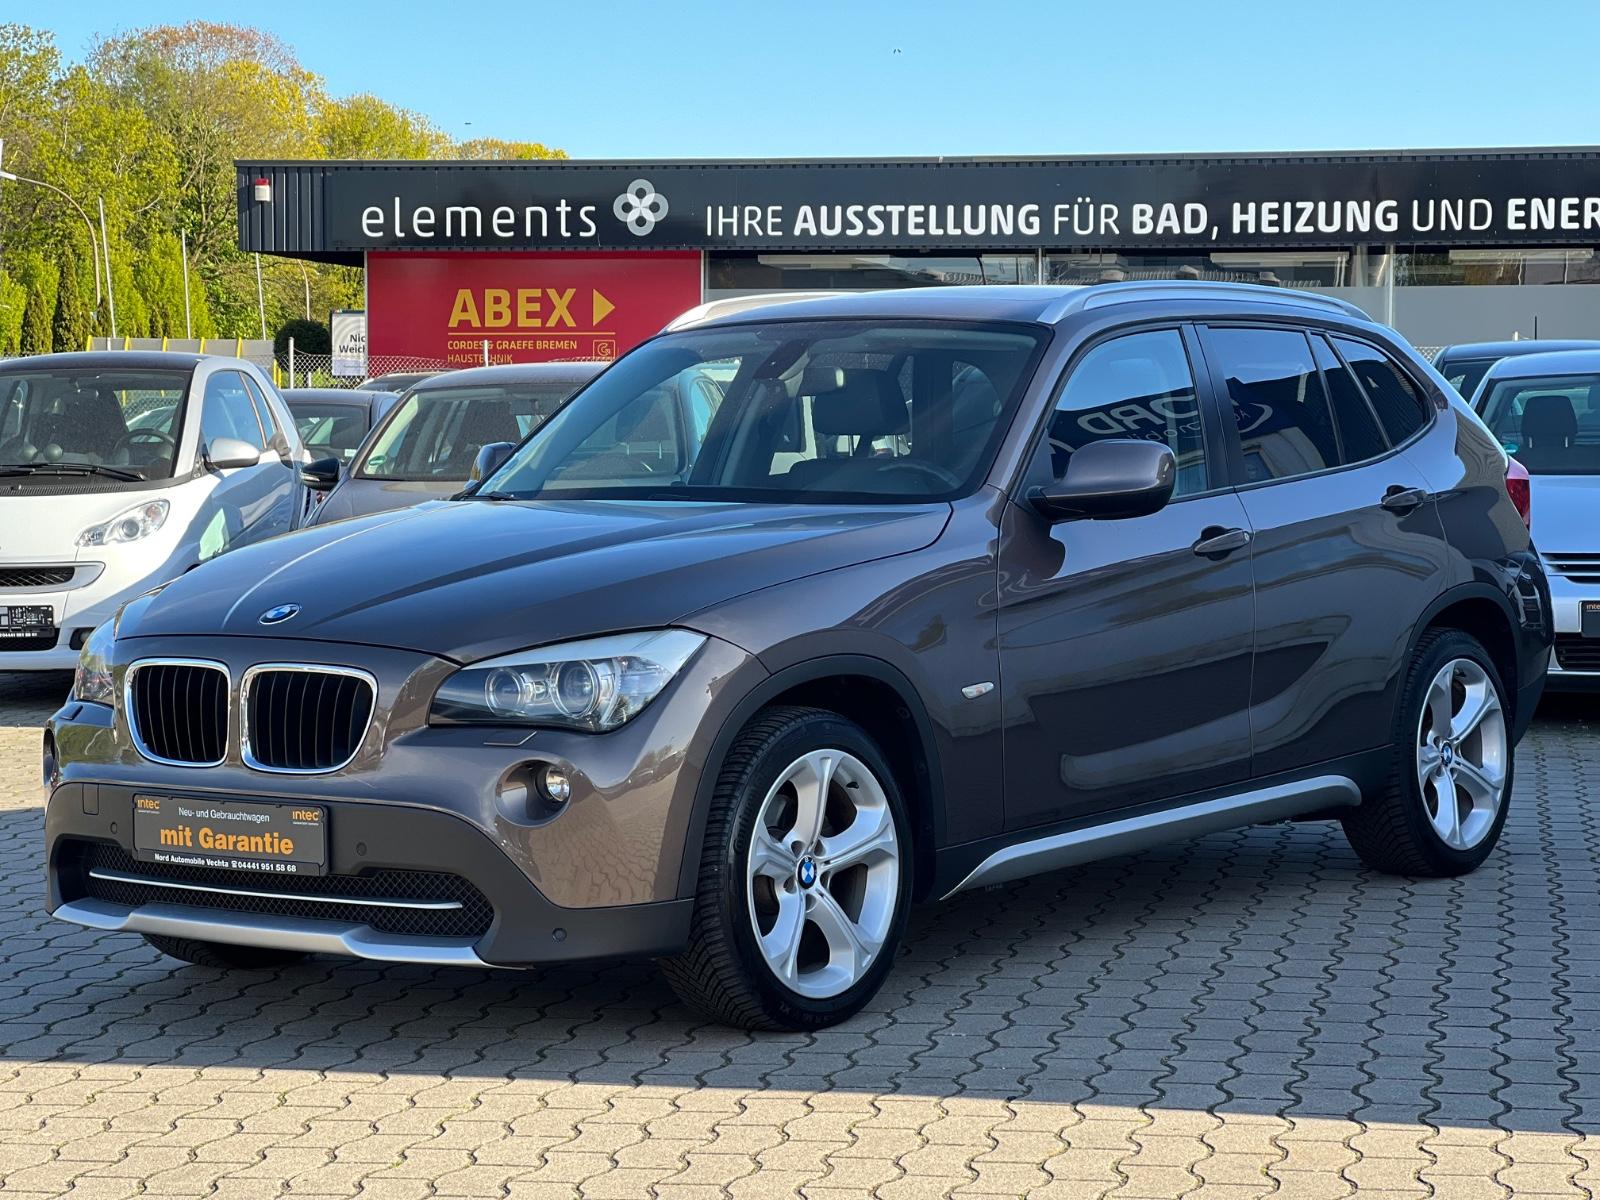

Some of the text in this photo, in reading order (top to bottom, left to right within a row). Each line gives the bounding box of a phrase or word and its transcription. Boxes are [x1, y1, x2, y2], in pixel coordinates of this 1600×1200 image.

[361, 196, 597, 238] elements
[705, 196, 1600, 241] IHRE AUSSTELLUNG FÜR BAD, HEIZUNG UND ENER
[447, 288, 577, 328] ABEX
[447, 340, 484, 350] CORDES
[496, 340, 534, 350] GRAEFE
[536, 340, 578, 350] BREMEN
[447, 353, 513, 365] HAUSTEHNIK
[137, 798, 161, 810] intec
[178, 806, 270, 824] Neu- und Gebrauchtwagen
[292, 809, 319, 821] intec
[160, 825, 294, 855] mit Garantie
[154, 853, 170, 862] Nord
[170, 855, 206, 866] Automobile
[206, 857, 229, 868] Vechta
